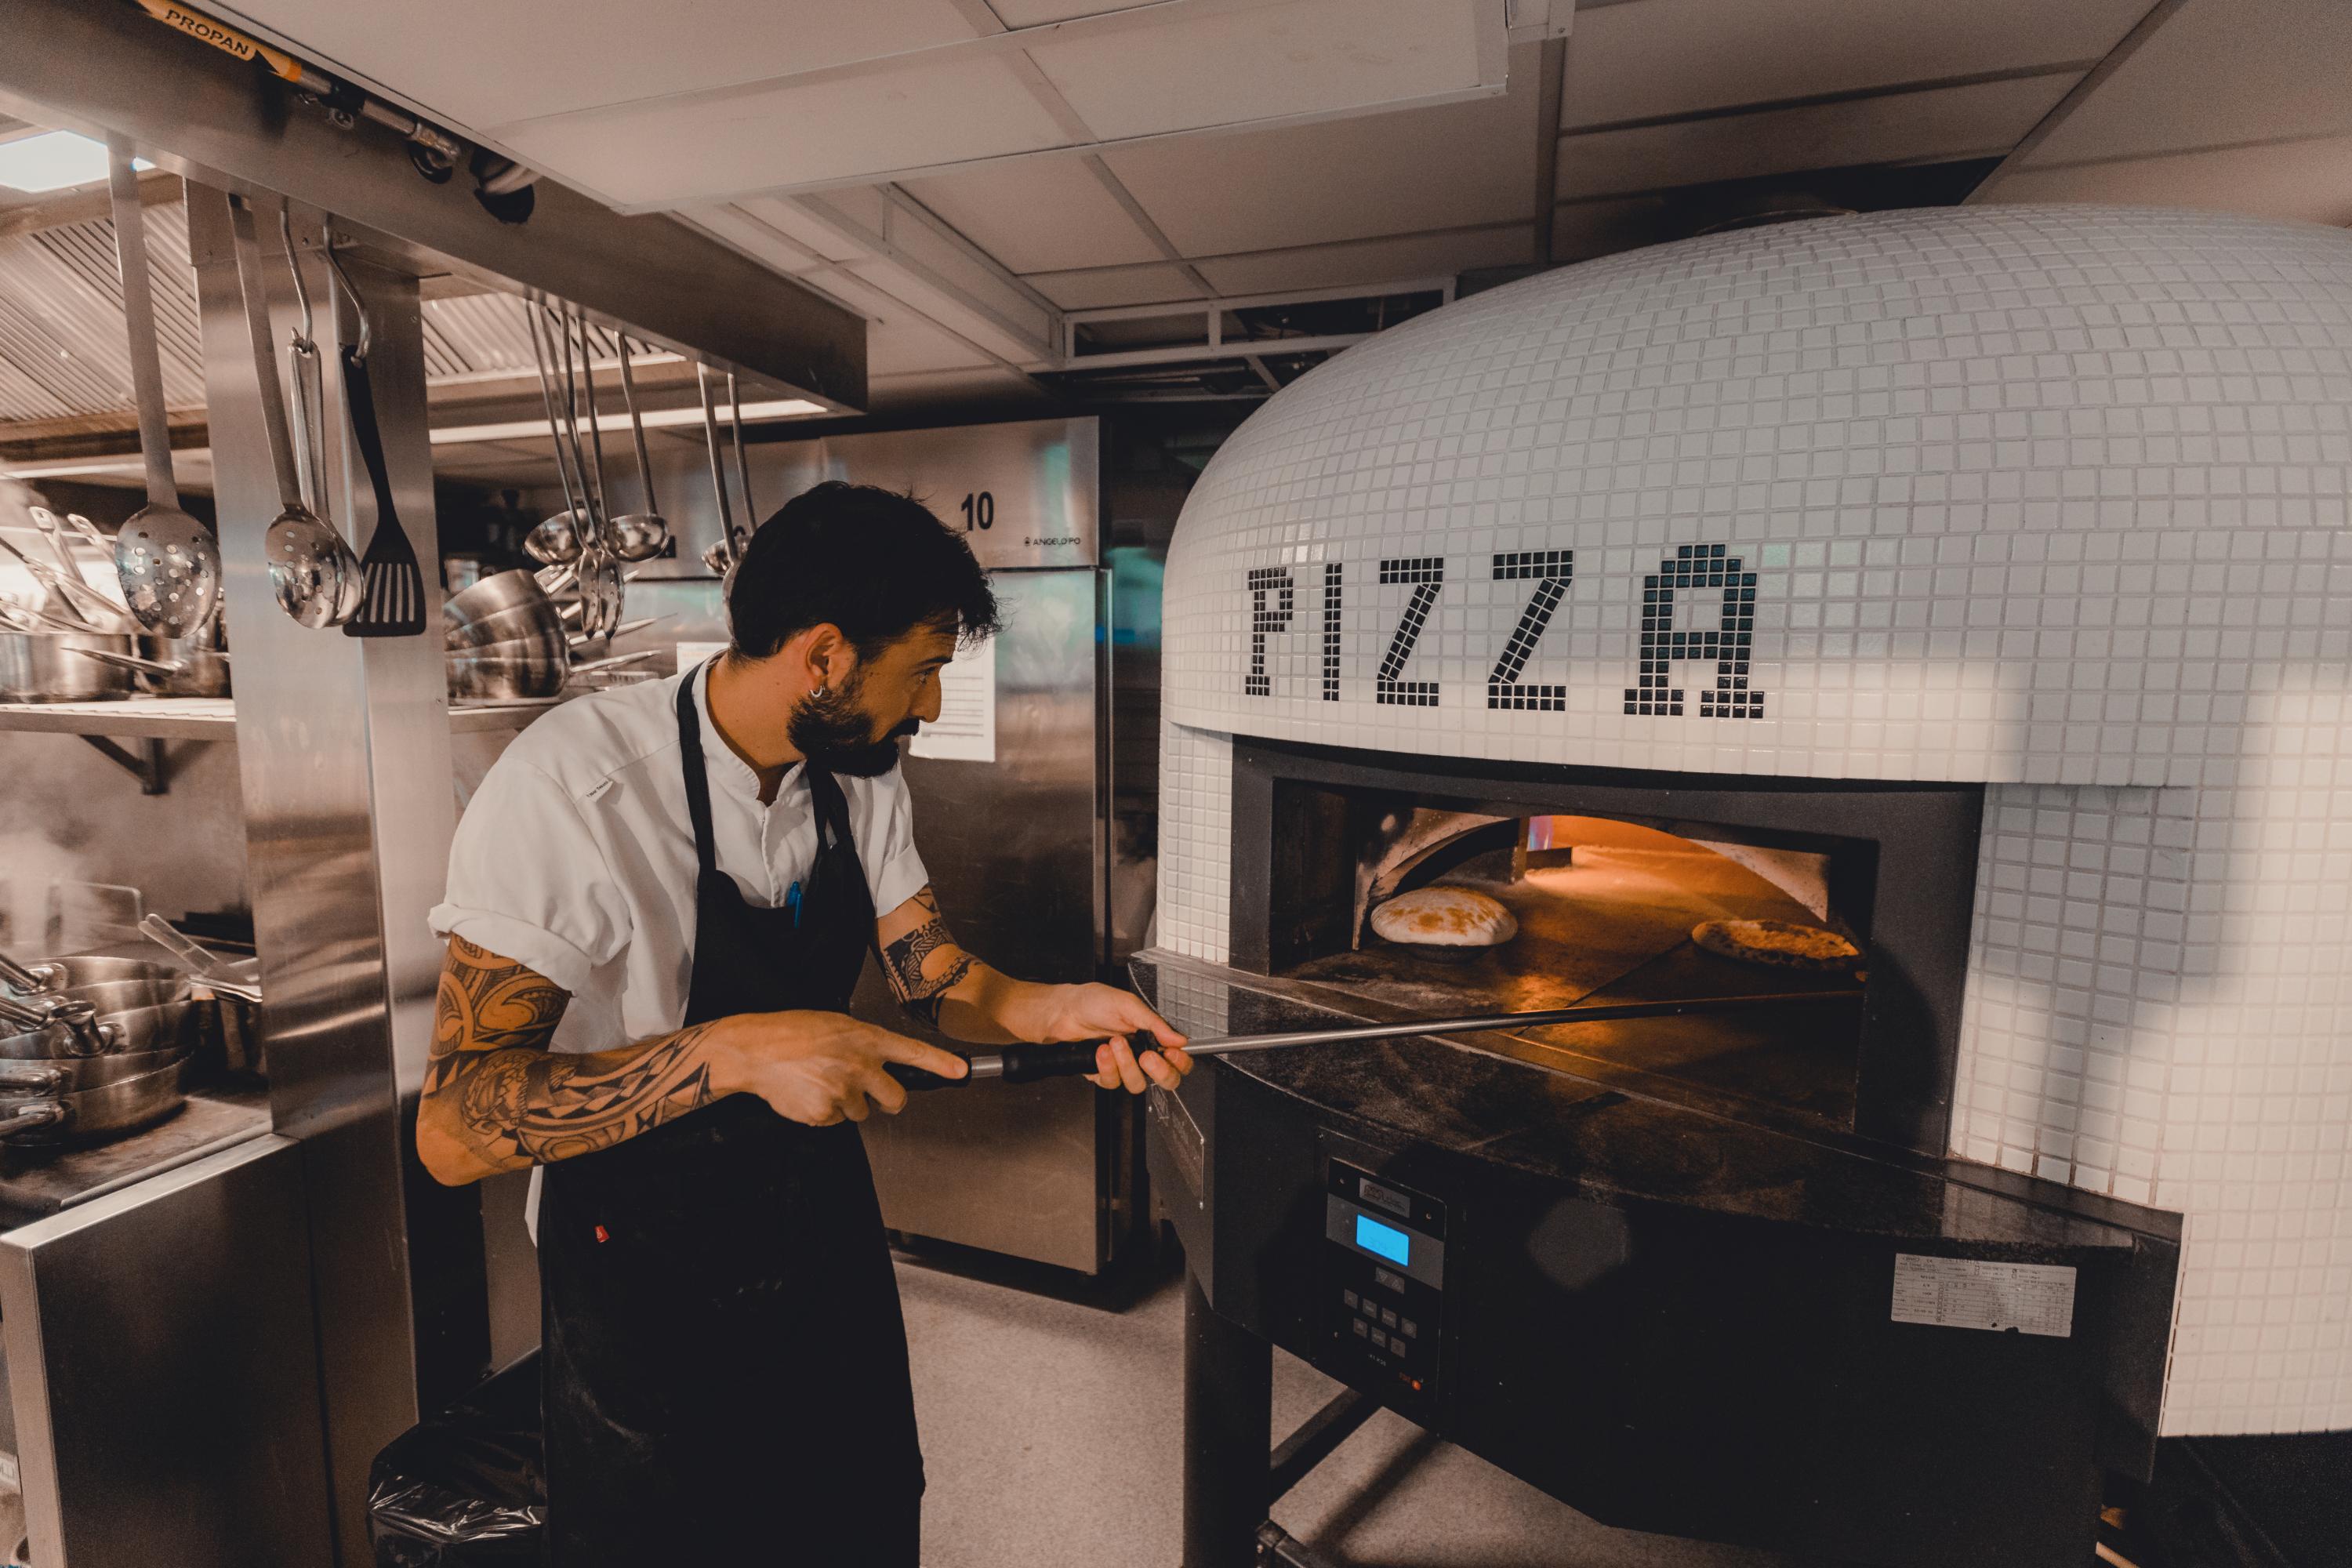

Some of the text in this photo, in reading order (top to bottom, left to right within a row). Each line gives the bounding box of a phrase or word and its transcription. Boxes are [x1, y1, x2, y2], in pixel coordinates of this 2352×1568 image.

[165, 9, 249, 55] PROPAN
[961, 491, 994, 532] 10
[1245, 544, 1765, 719] PIZZA
